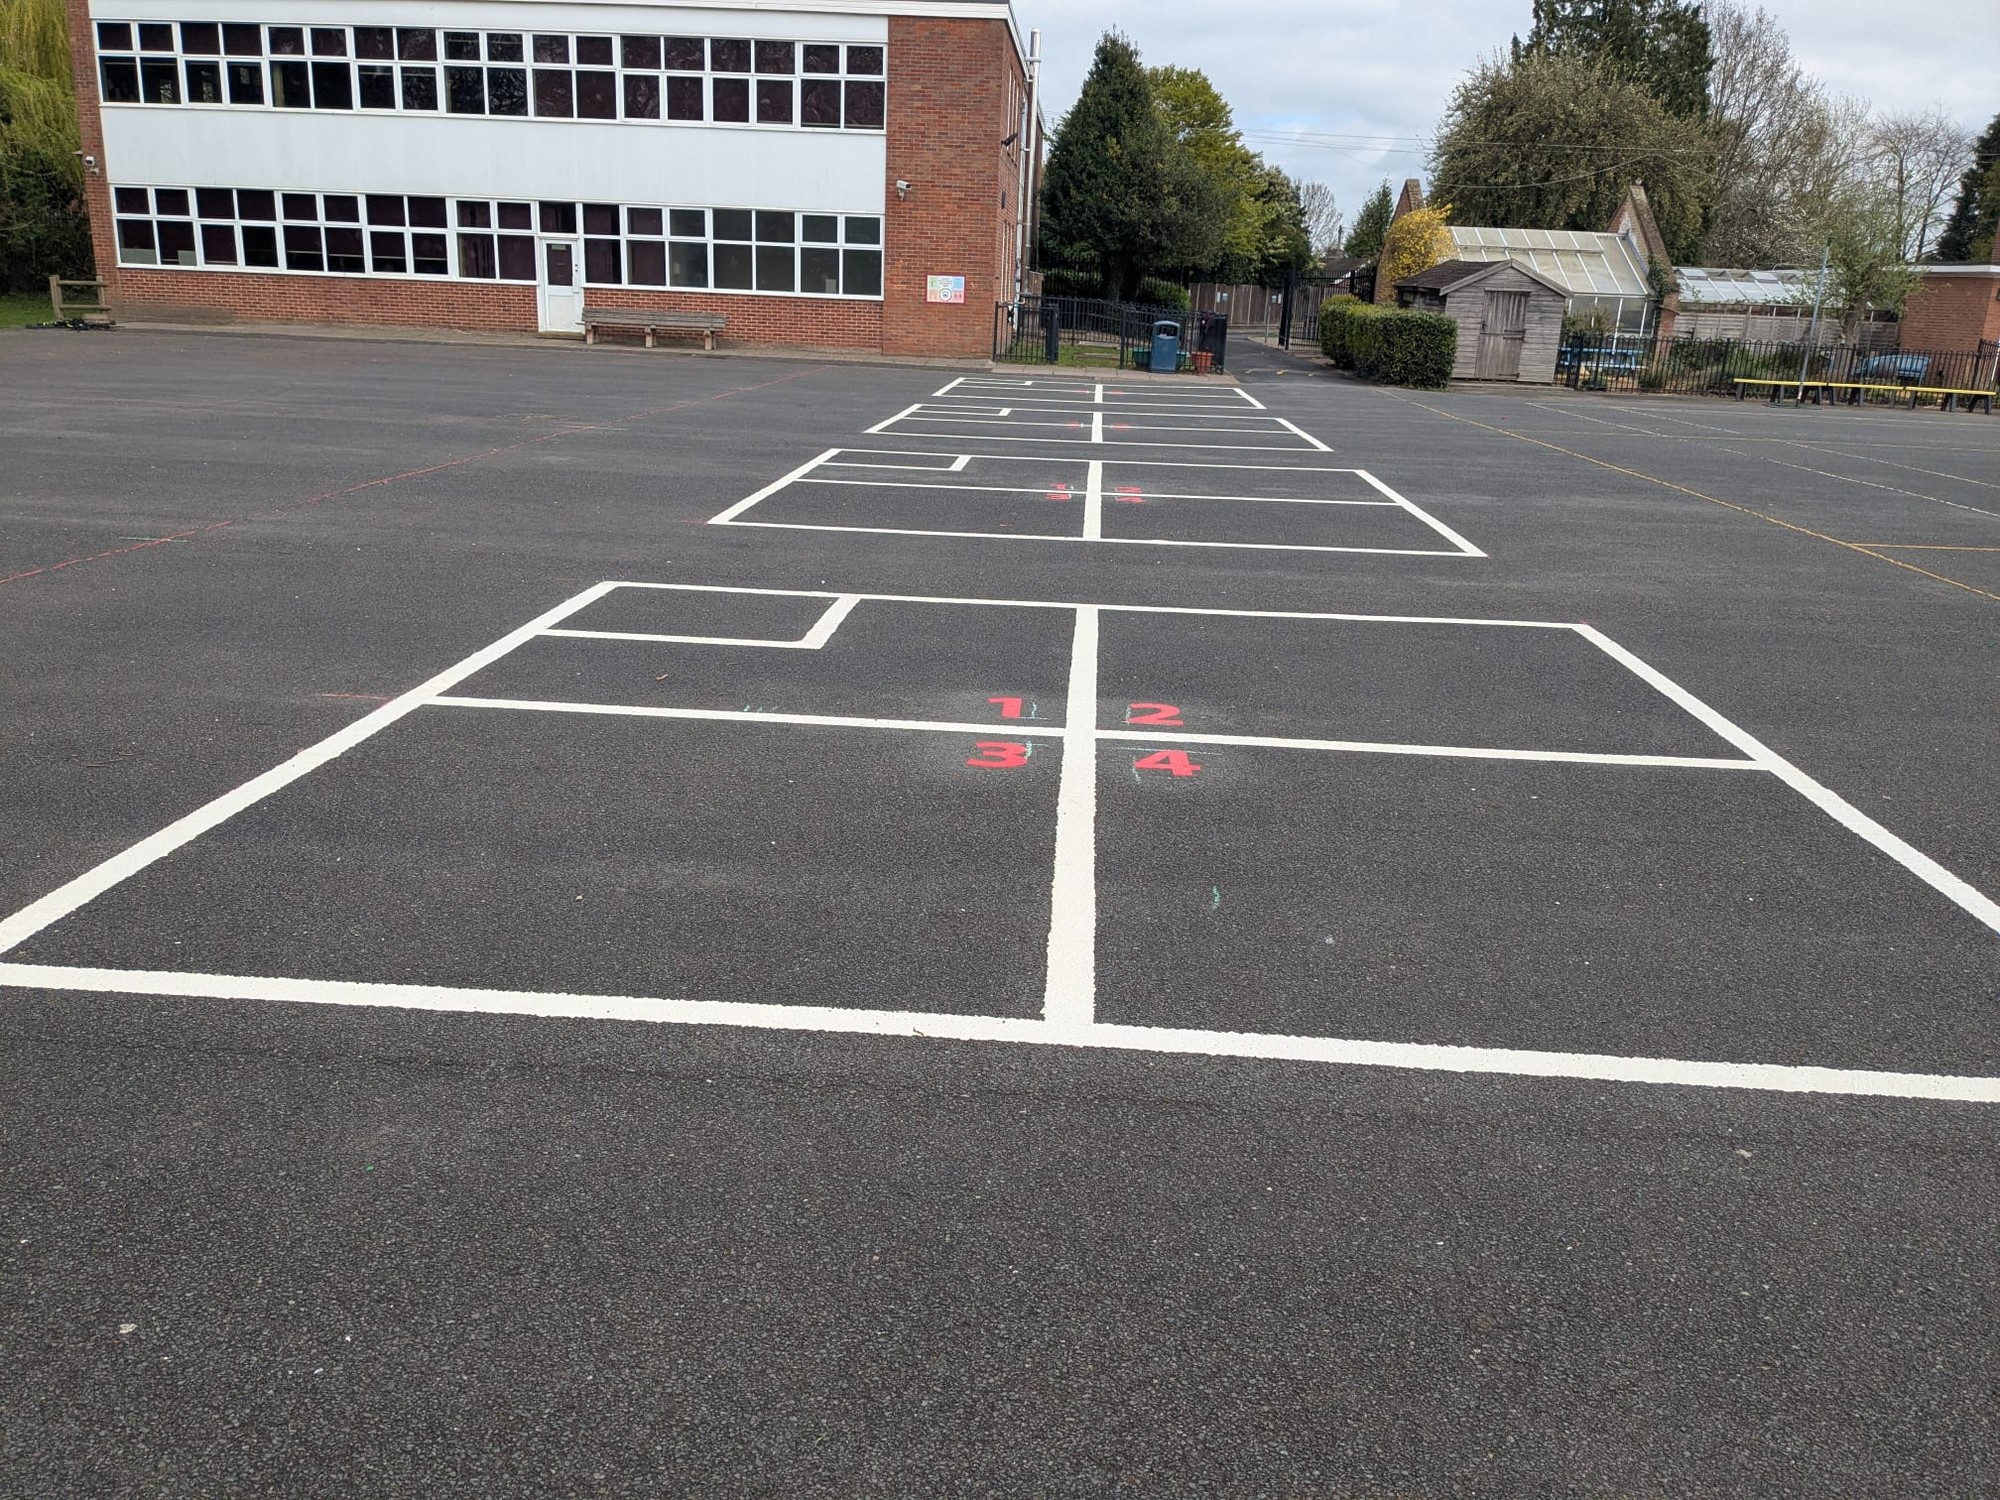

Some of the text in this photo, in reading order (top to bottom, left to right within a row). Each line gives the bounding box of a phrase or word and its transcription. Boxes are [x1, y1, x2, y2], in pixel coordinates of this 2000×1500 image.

[988, 697, 1022, 718] 1
[1127, 703, 1184, 726] 2
[966, 741, 1028, 768] 3
[1134, 750, 1201, 777] 4
